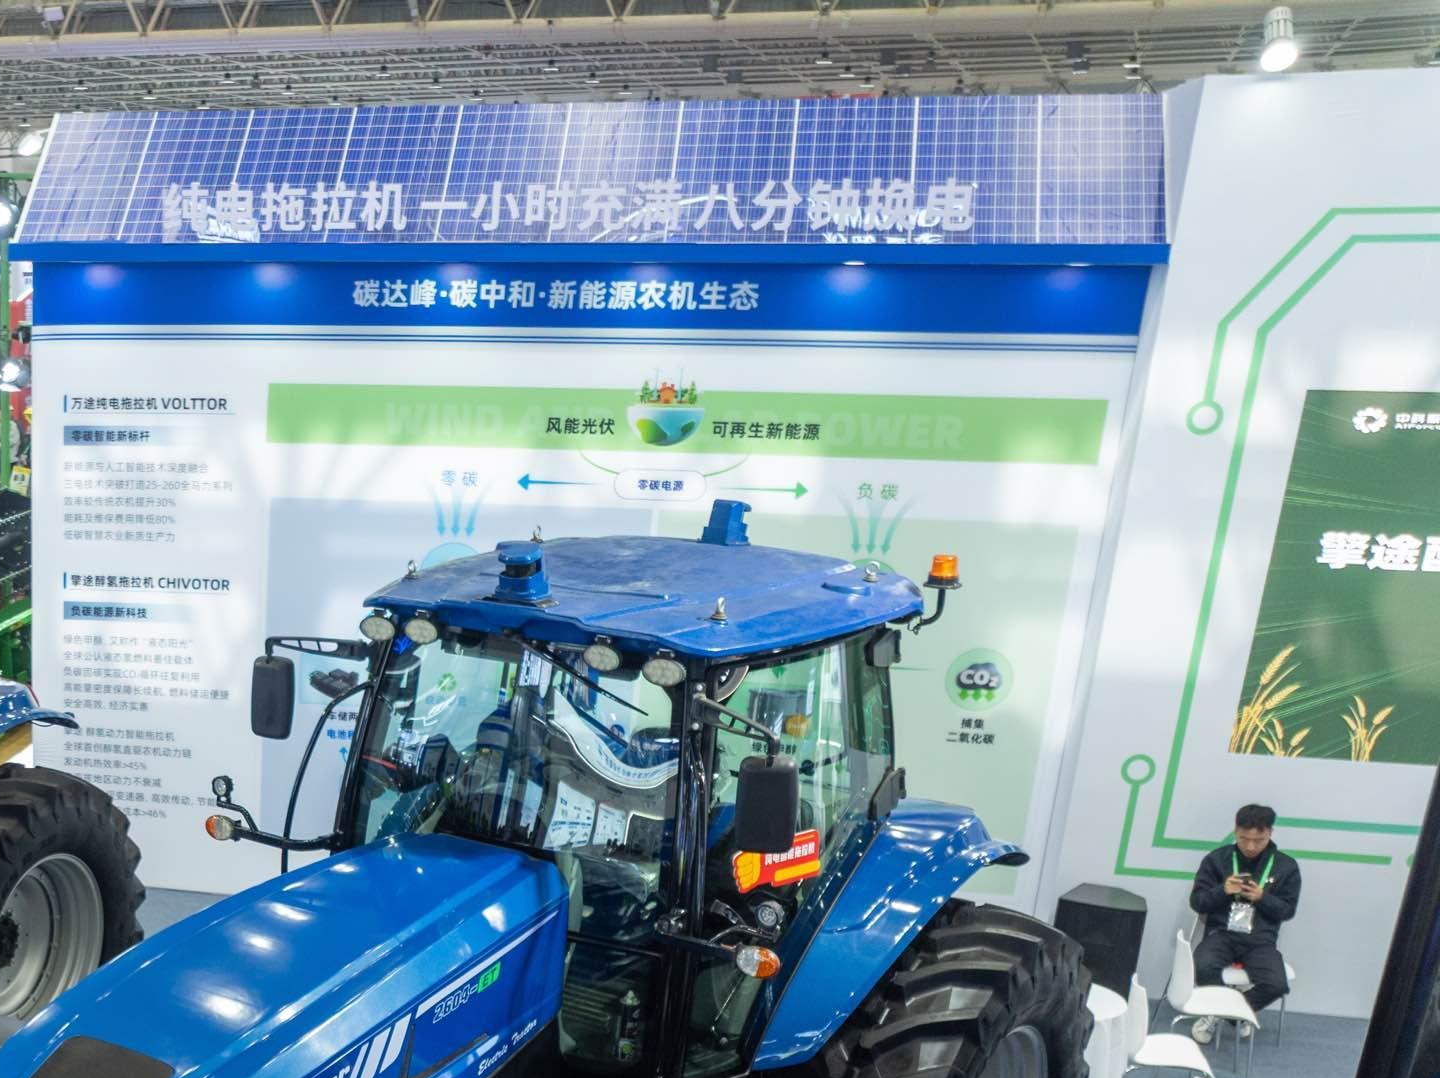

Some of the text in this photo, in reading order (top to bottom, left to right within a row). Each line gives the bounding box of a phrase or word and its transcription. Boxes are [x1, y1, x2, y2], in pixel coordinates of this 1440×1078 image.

[71, 397, 228, 411] 万途纯电拖拉机 VOLTTOR
[544, 415, 616, 438] 风能光伏
[711, 418, 822, 443] 可再生新能源
[637, 479, 685, 492] 零碳电源
[856, 482, 899, 501] 负碳
[158, 577, 230, 591] CHIVOTOR
[946, 731, 996, 744] 二氧化碳
[477, 1018, 538, 1077] Electric Tractor
